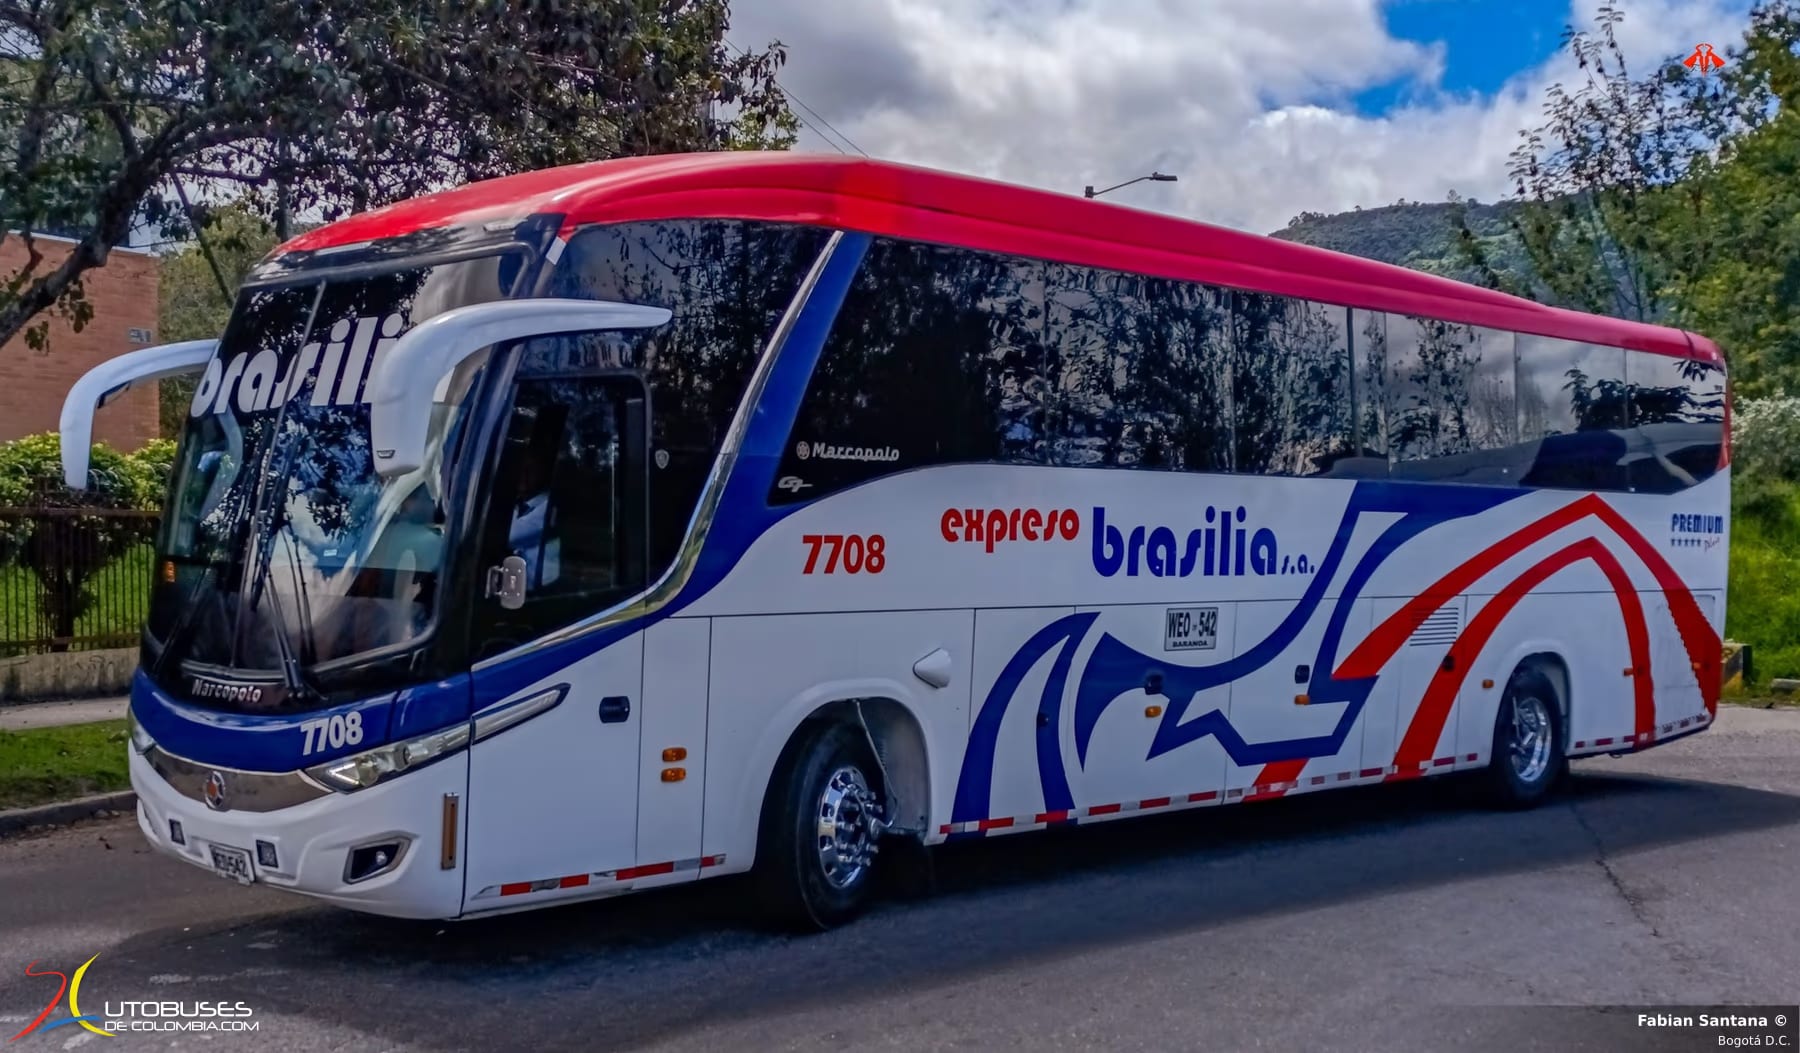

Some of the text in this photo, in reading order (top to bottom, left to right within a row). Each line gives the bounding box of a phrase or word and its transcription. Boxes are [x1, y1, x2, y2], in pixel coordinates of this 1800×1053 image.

[190, 313, 453, 418] brasili
[812, 442, 900, 462] Marcopolo
[940, 508, 1080, 553] expreso
[1092, 505, 1278, 577] brasilia
[1671, 513, 1723, 534] PREMIUM
[802, 534, 886, 574] 7708
[1168, 612, 1191, 638] WEO
[300, 711, 364, 756] 7708
